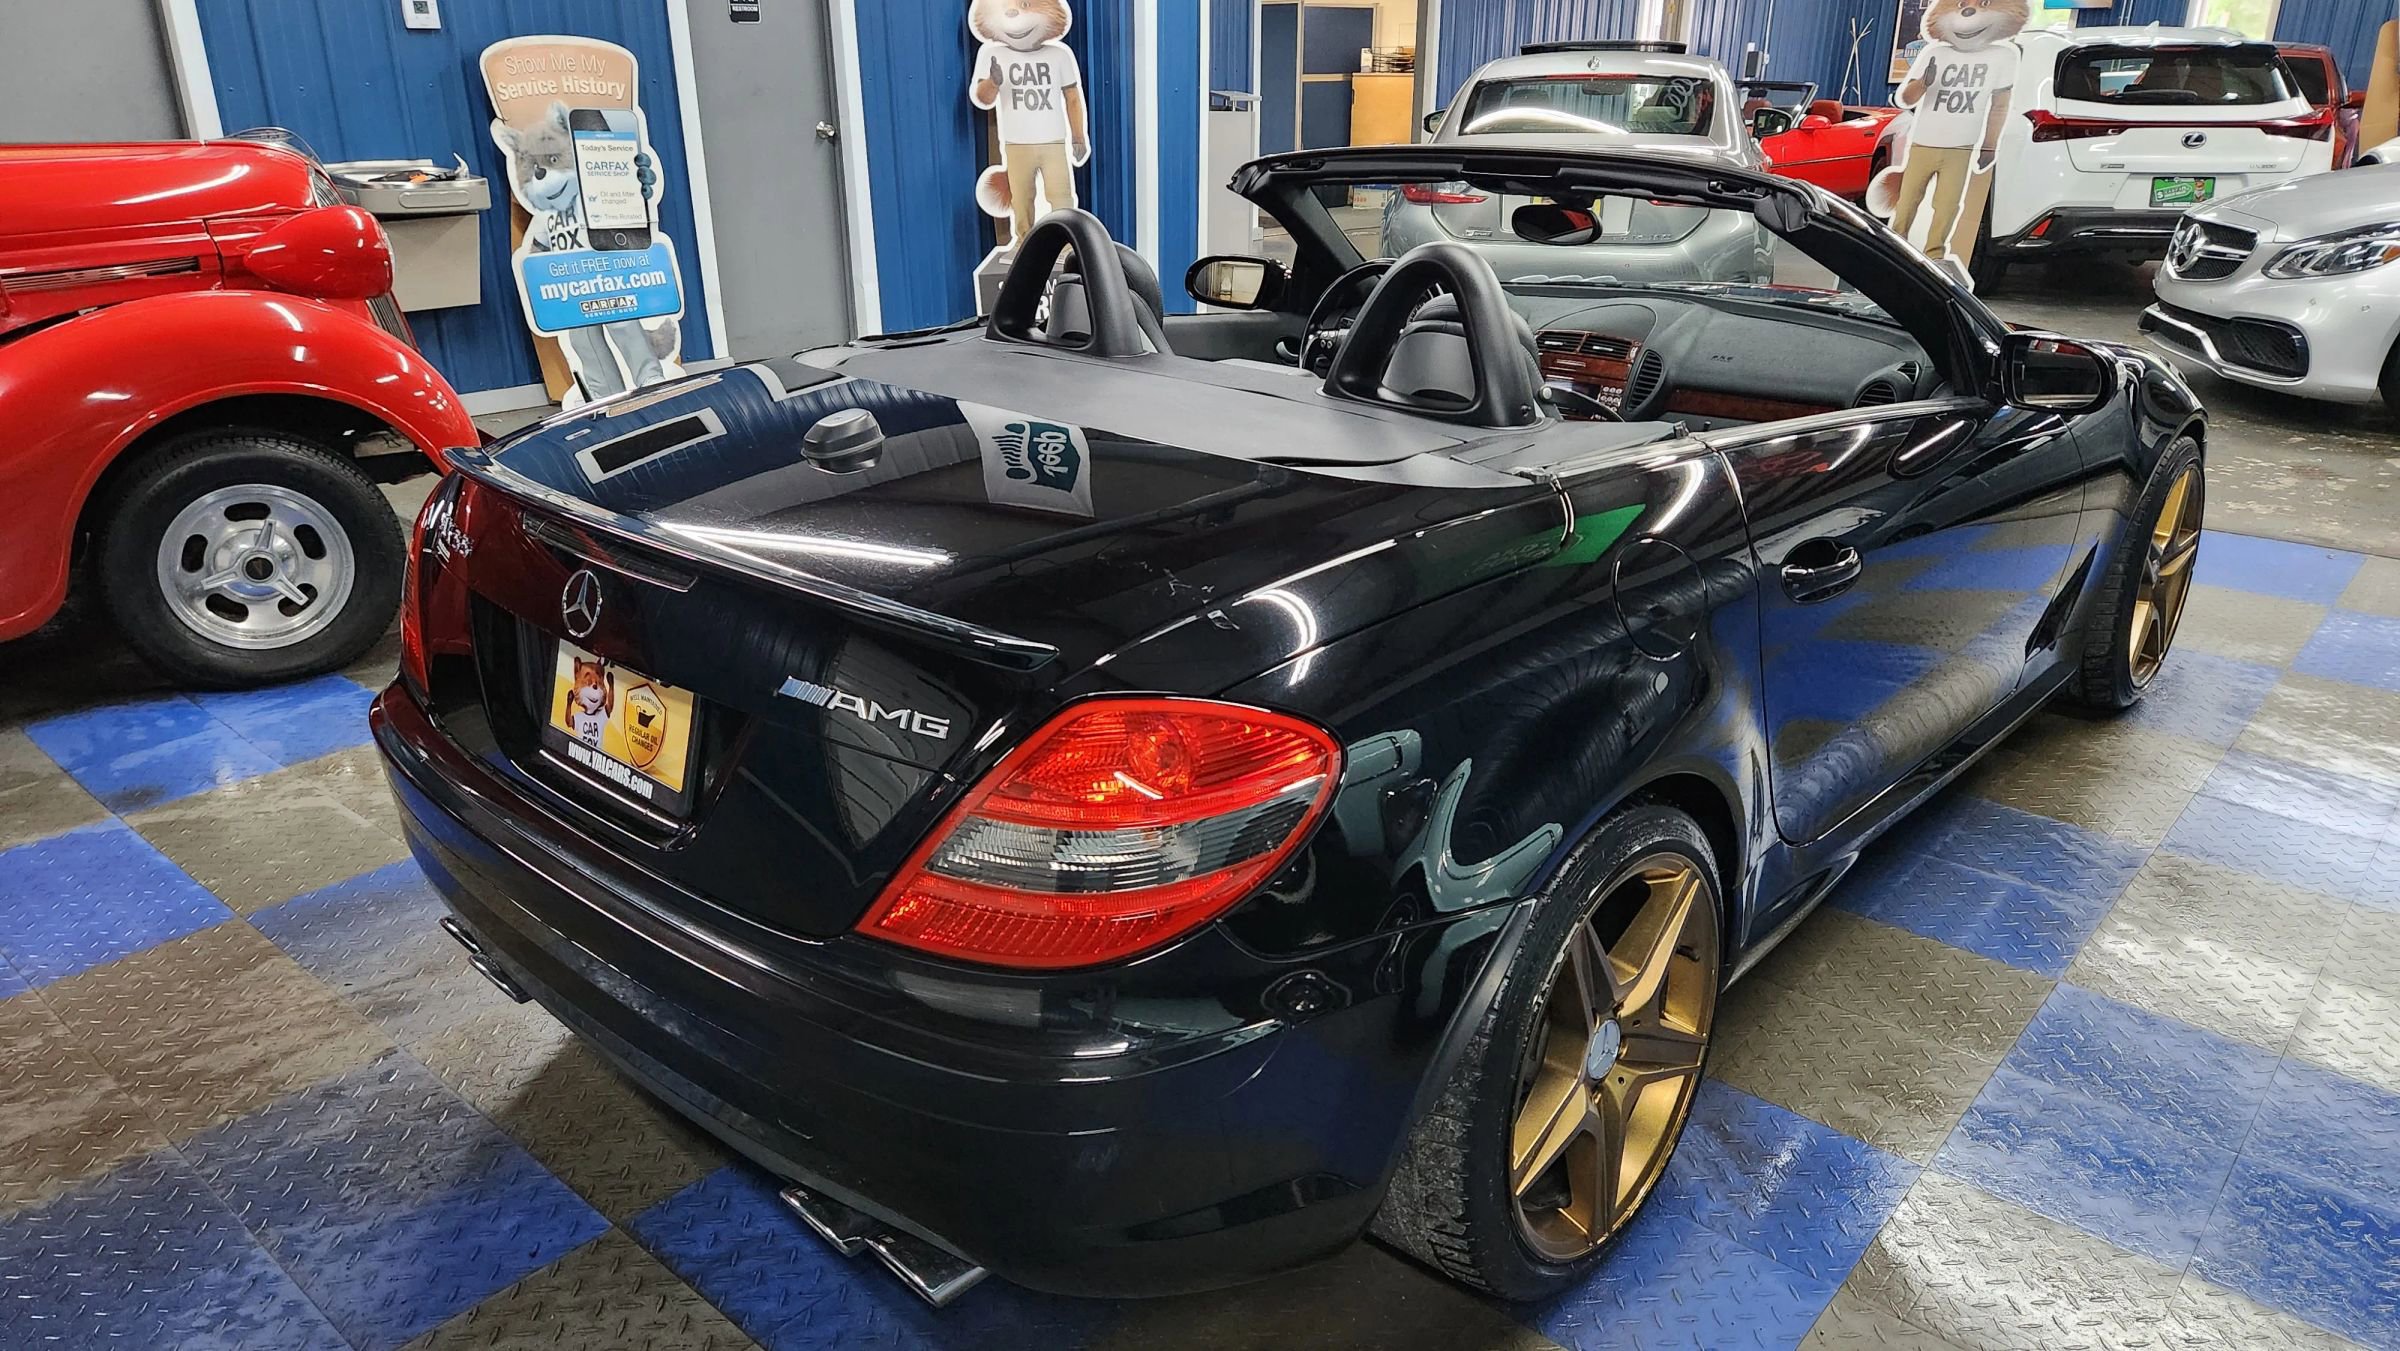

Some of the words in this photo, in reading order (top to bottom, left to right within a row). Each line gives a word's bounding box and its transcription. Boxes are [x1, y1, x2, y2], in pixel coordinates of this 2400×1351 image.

[504, 54, 547, 75] Show
[551, 53, 577, 73] Me
[581, 54, 607, 77] My
[1008, 62, 1052, 86] CAR
[1940, 63, 1989, 88] CAR
[496, 79, 558, 102] Service
[562, 75, 626, 101] History
[1011, 88, 1054, 112] FOX
[1933, 90, 1980, 114] FOX
[581, 144, 607, 152] Today's
[607, 144, 634, 152] Service
[585, 161, 630, 170] CARFAX
[547, 205, 578, 233] CAR
[550, 227, 585, 251] FOX
[548, 261, 571, 278] Get
[571, 260, 581, 273] it
[581, 257, 612, 273] FREE
[613, 256, 637, 269] now
[638, 254, 651, 266] at
[540, 269, 667, 302] mycarfax.com
[580, 296, 637, 312] CARFAX
[826, 690, 951, 740] AMG
[583, 721, 599, 738] CAR
